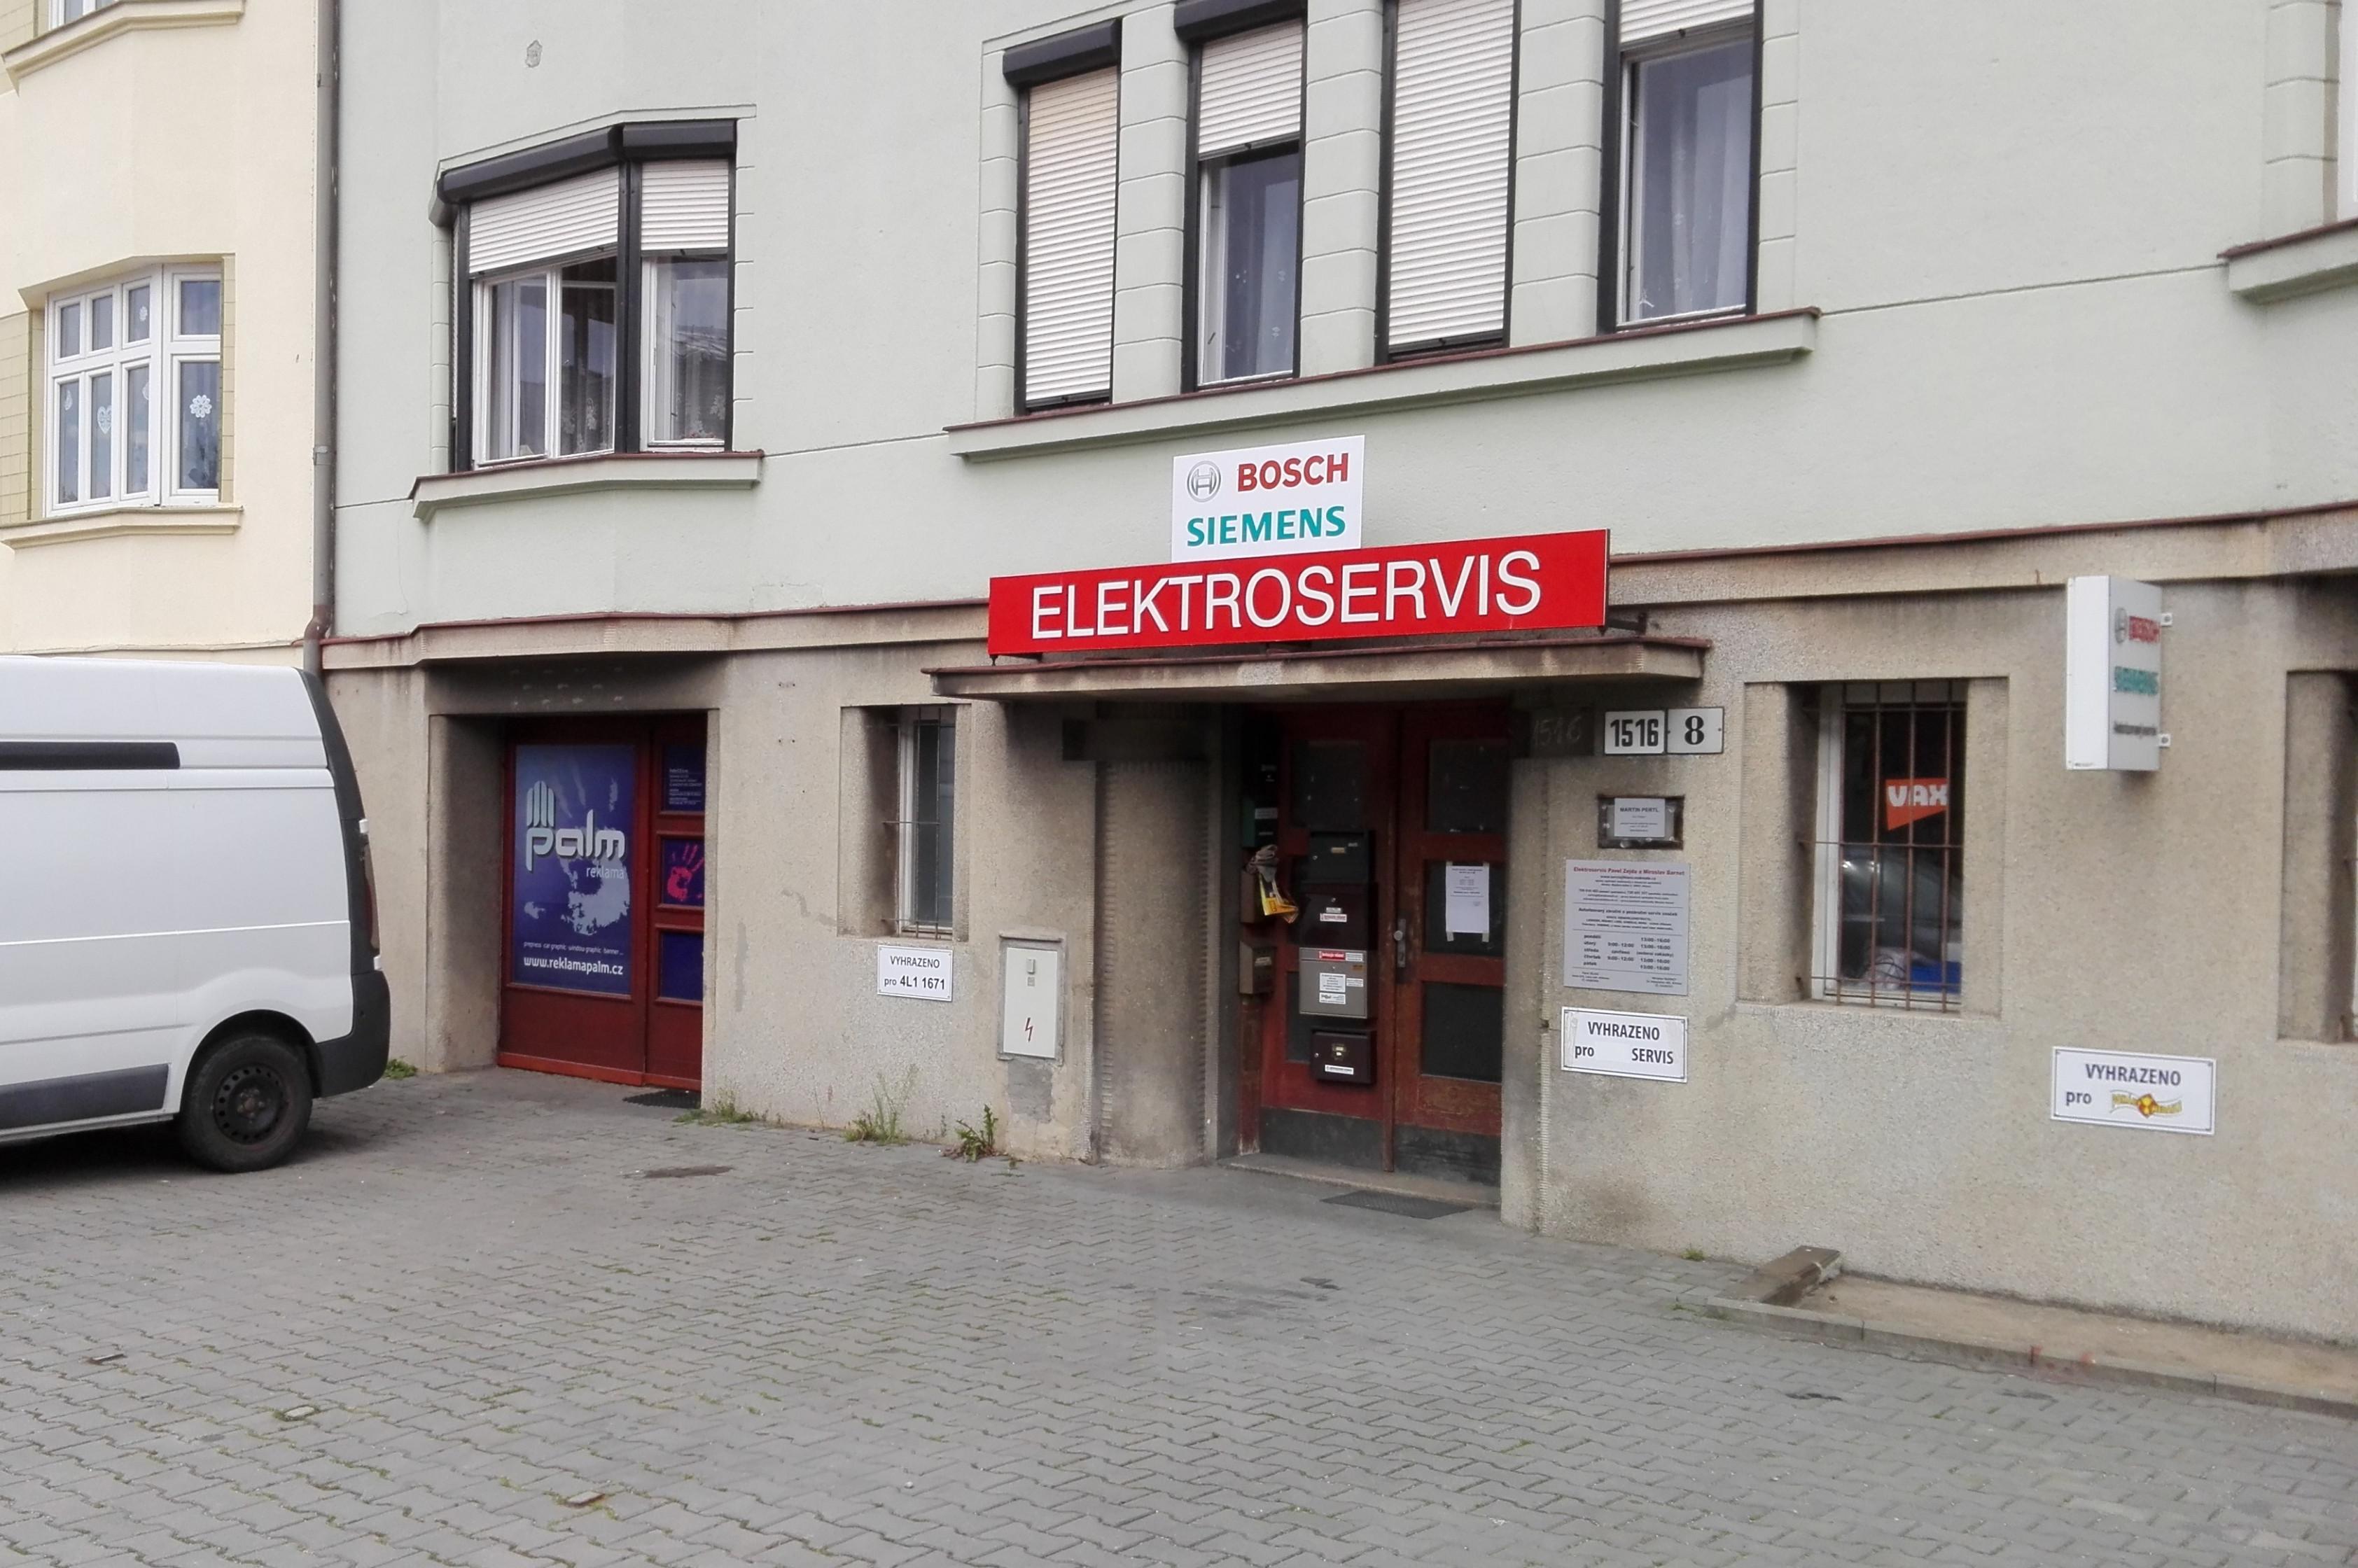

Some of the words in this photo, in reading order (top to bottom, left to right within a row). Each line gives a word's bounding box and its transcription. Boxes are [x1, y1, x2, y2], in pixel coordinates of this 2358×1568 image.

[1237, 453, 1348, 492] BOSCH
[1187, 505, 1346, 547] SIEMENS
[1032, 550, 1540, 640] ELEKTROSERVIS
[1610, 718, 1659, 747] 1516
[1684, 715, 1704, 745] 8
[1888, 784, 1948, 807] VAX
[526, 809, 625, 872] palm
[586, 865, 625, 880] reklama
[524, 955, 624, 975] www.reklamapalm.cz
[890, 955, 940, 969] VYHRAZENO
[884, 977, 897, 987] pro
[900, 975, 918, 988] 4L1
[922, 976, 945, 990] 1671
[1588, 1021, 1660, 1040] VYHRAZENO
[1575, 1045, 1594, 1058] pro
[1632, 1048, 1674, 1064] SERVIS
[2085, 1063, 2181, 1086] VYHRAZENO
[2066, 1091, 2092, 1106] pro
